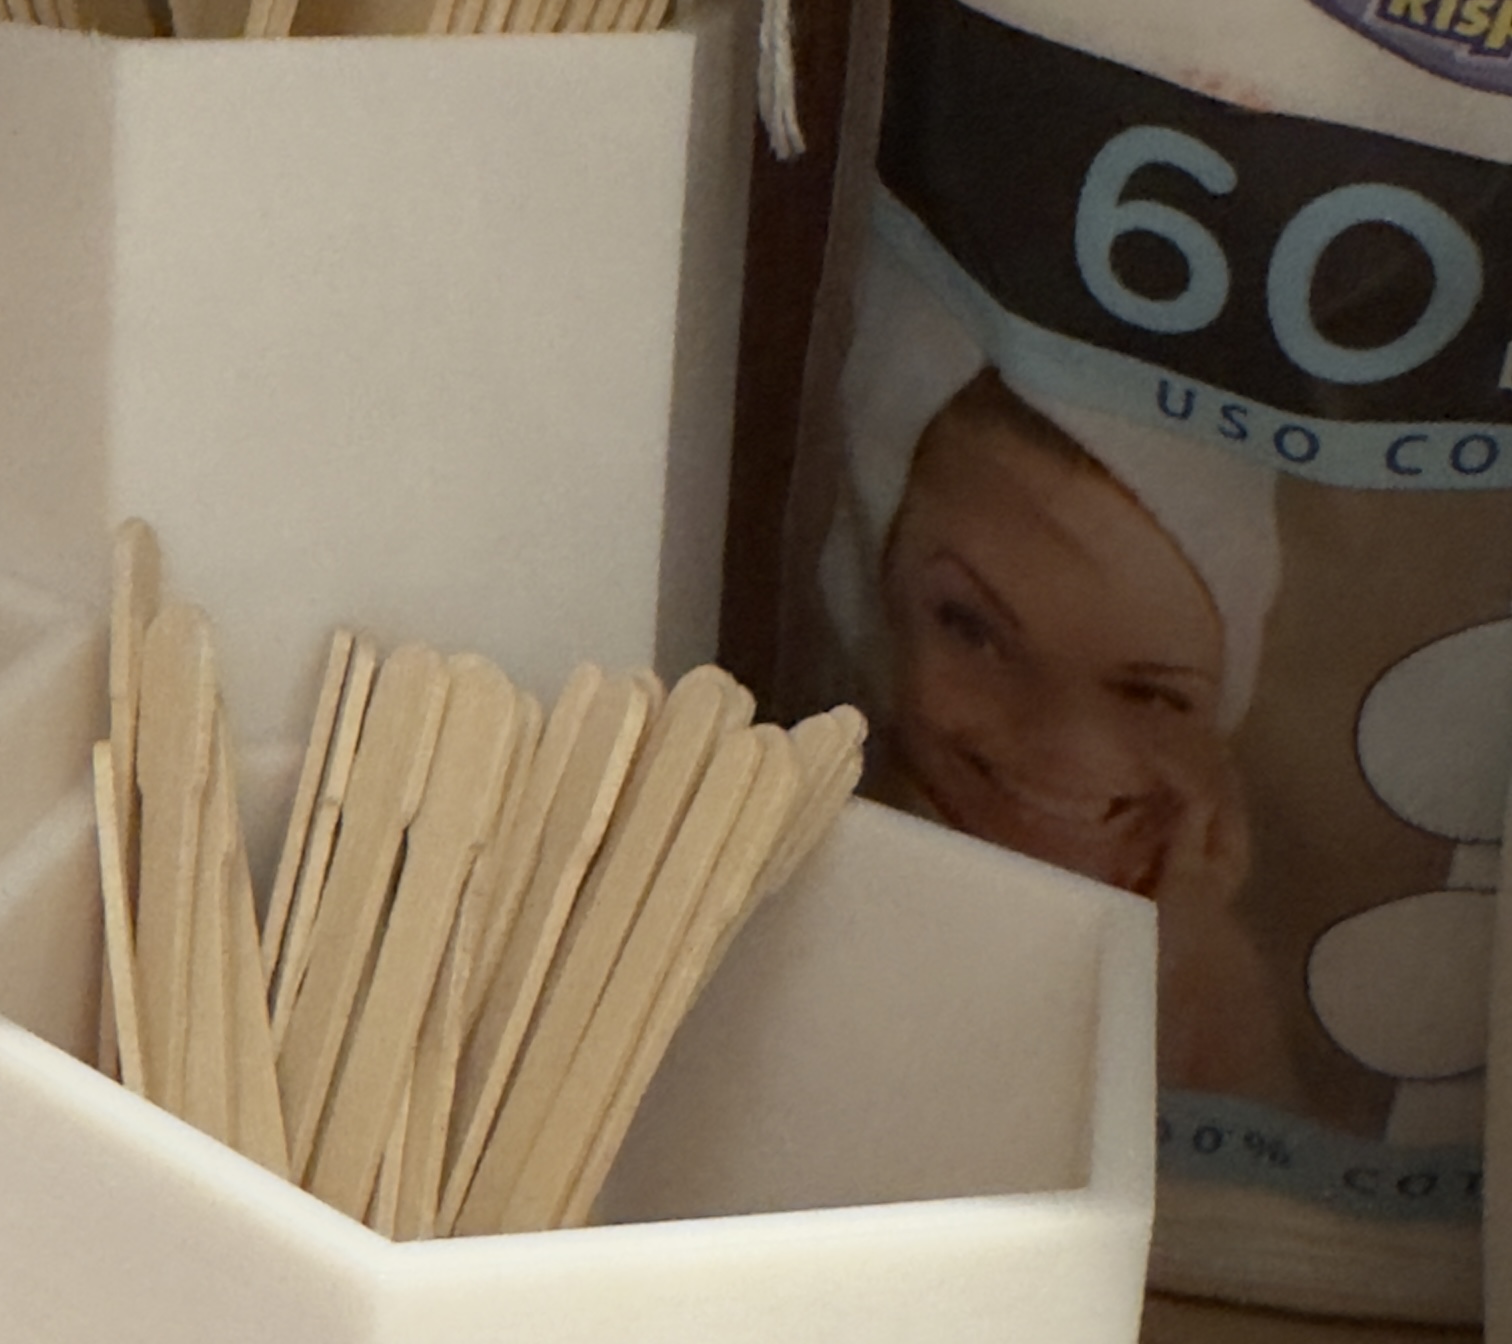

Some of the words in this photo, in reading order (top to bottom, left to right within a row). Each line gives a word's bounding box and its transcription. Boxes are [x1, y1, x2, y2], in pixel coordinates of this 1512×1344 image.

[1074, 124, 1483, 385] 60
[1157, 378, 1320, 463] USO
[1385, 433, 1500, 476] CO
